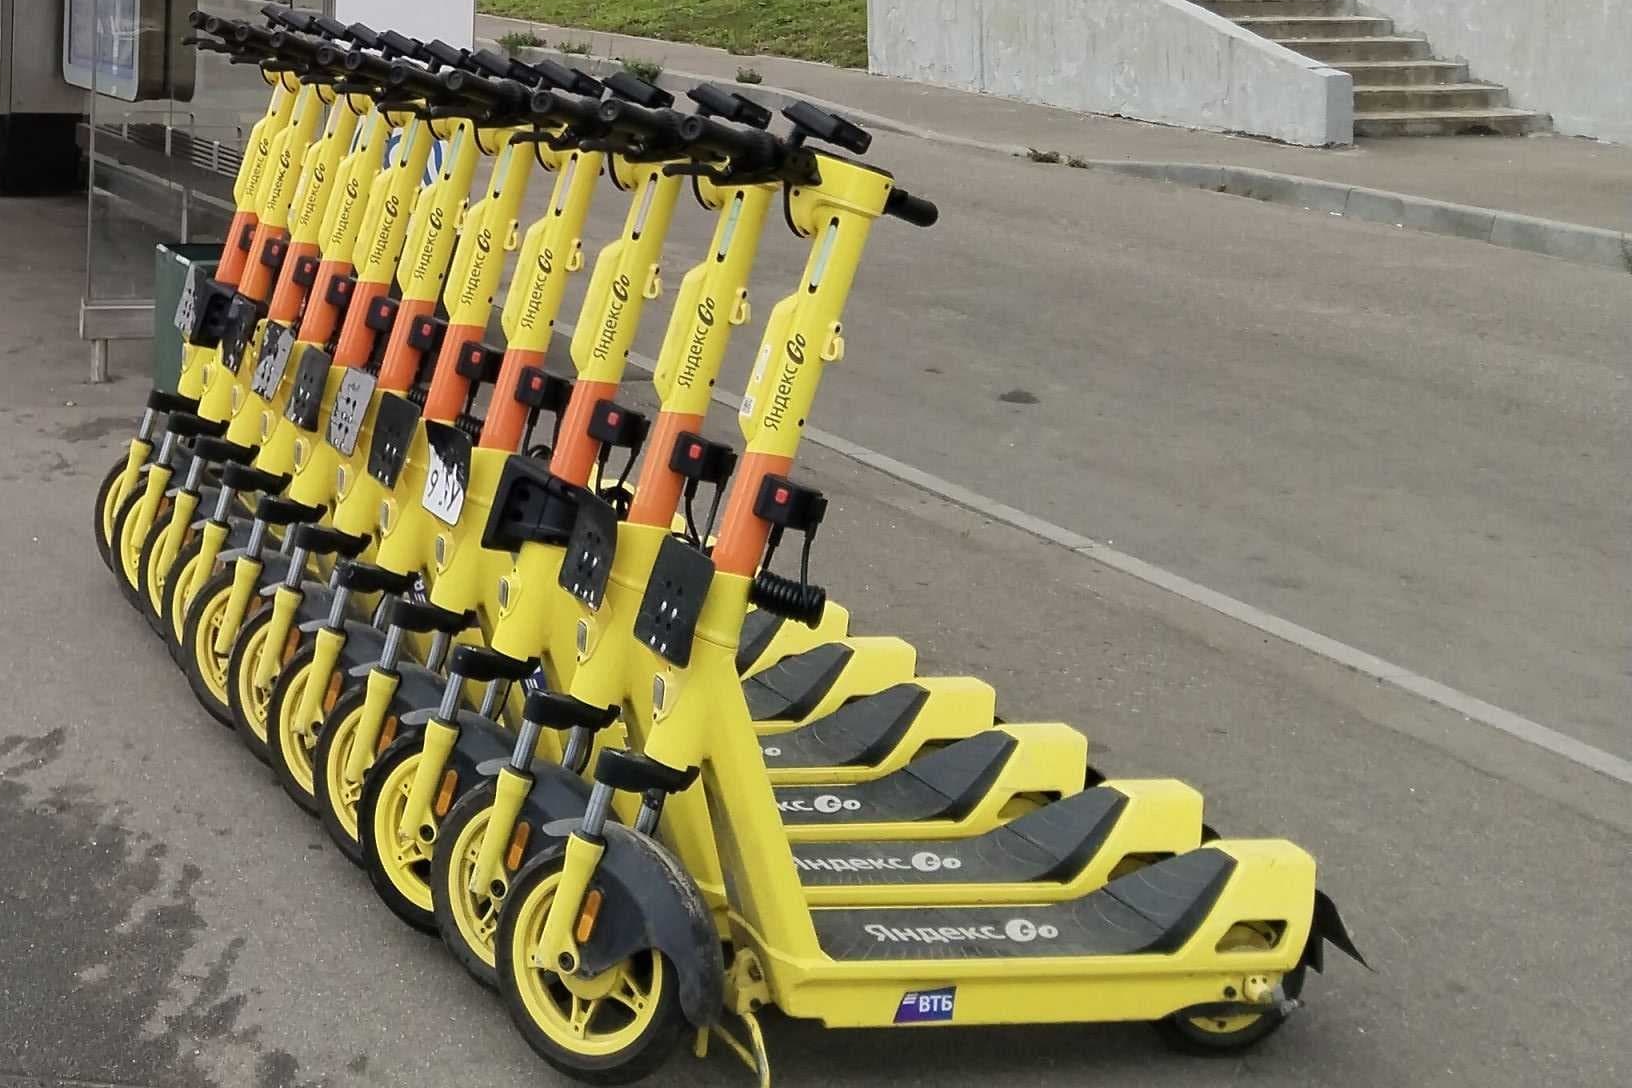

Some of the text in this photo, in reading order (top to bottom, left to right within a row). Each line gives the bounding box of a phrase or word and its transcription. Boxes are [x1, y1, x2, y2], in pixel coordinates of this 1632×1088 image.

[246, 138, 269, 196] Яндекс Go
[267, 150, 291, 210] Яндекс Go
[300, 163, 326, 225] Яндекс Go
[332, 178, 359, 244] Яндекс Go
[370, 195, 399, 264] Яндекс Go
[414, 208, 444, 280] Яндекс Go
[461, 229, 492, 305] Яндекс Go
[521, 248, 553, 329] Яндекс Go
[593, 274, 630, 360] Яндекс Go
[678, 296, 715, 388] Яндекс Go
[764, 333, 806, 431] Яндекс Go
[911, 851, 962, 872] Go
[864, 918, 1059, 944] Яндекс Go
[918, 994, 953, 1013] ВТБ
